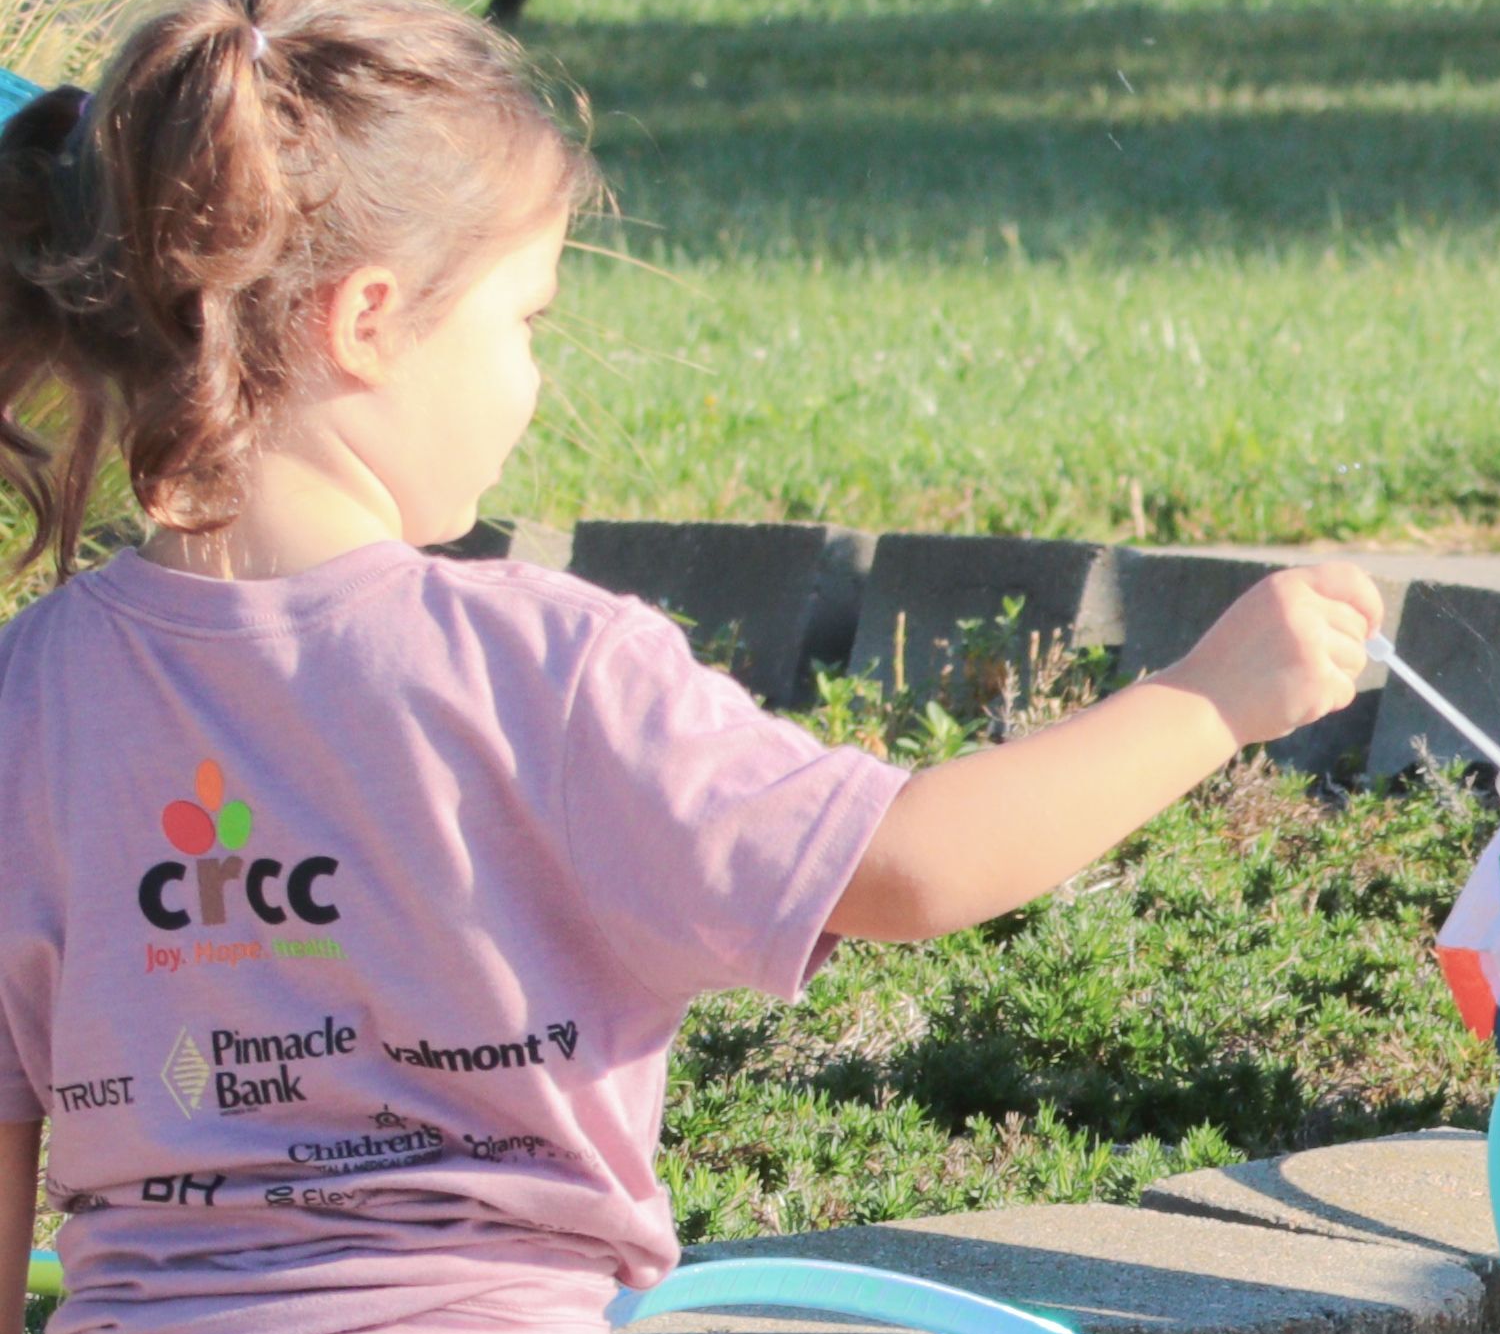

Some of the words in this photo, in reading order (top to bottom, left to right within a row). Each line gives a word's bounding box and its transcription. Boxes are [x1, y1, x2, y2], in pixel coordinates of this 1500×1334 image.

[138, 855, 341, 931] crcc
[146, 943, 187, 973] Joy.
[194, 939, 272, 971] Hope.
[212, 1016, 357, 1066] Pinnacle
[382, 1033, 545, 1073] valmont
[56, 1076, 134, 1113] TRUST
[215, 1064, 306, 1109] Bank
[288, 1123, 444, 1164] Children's
